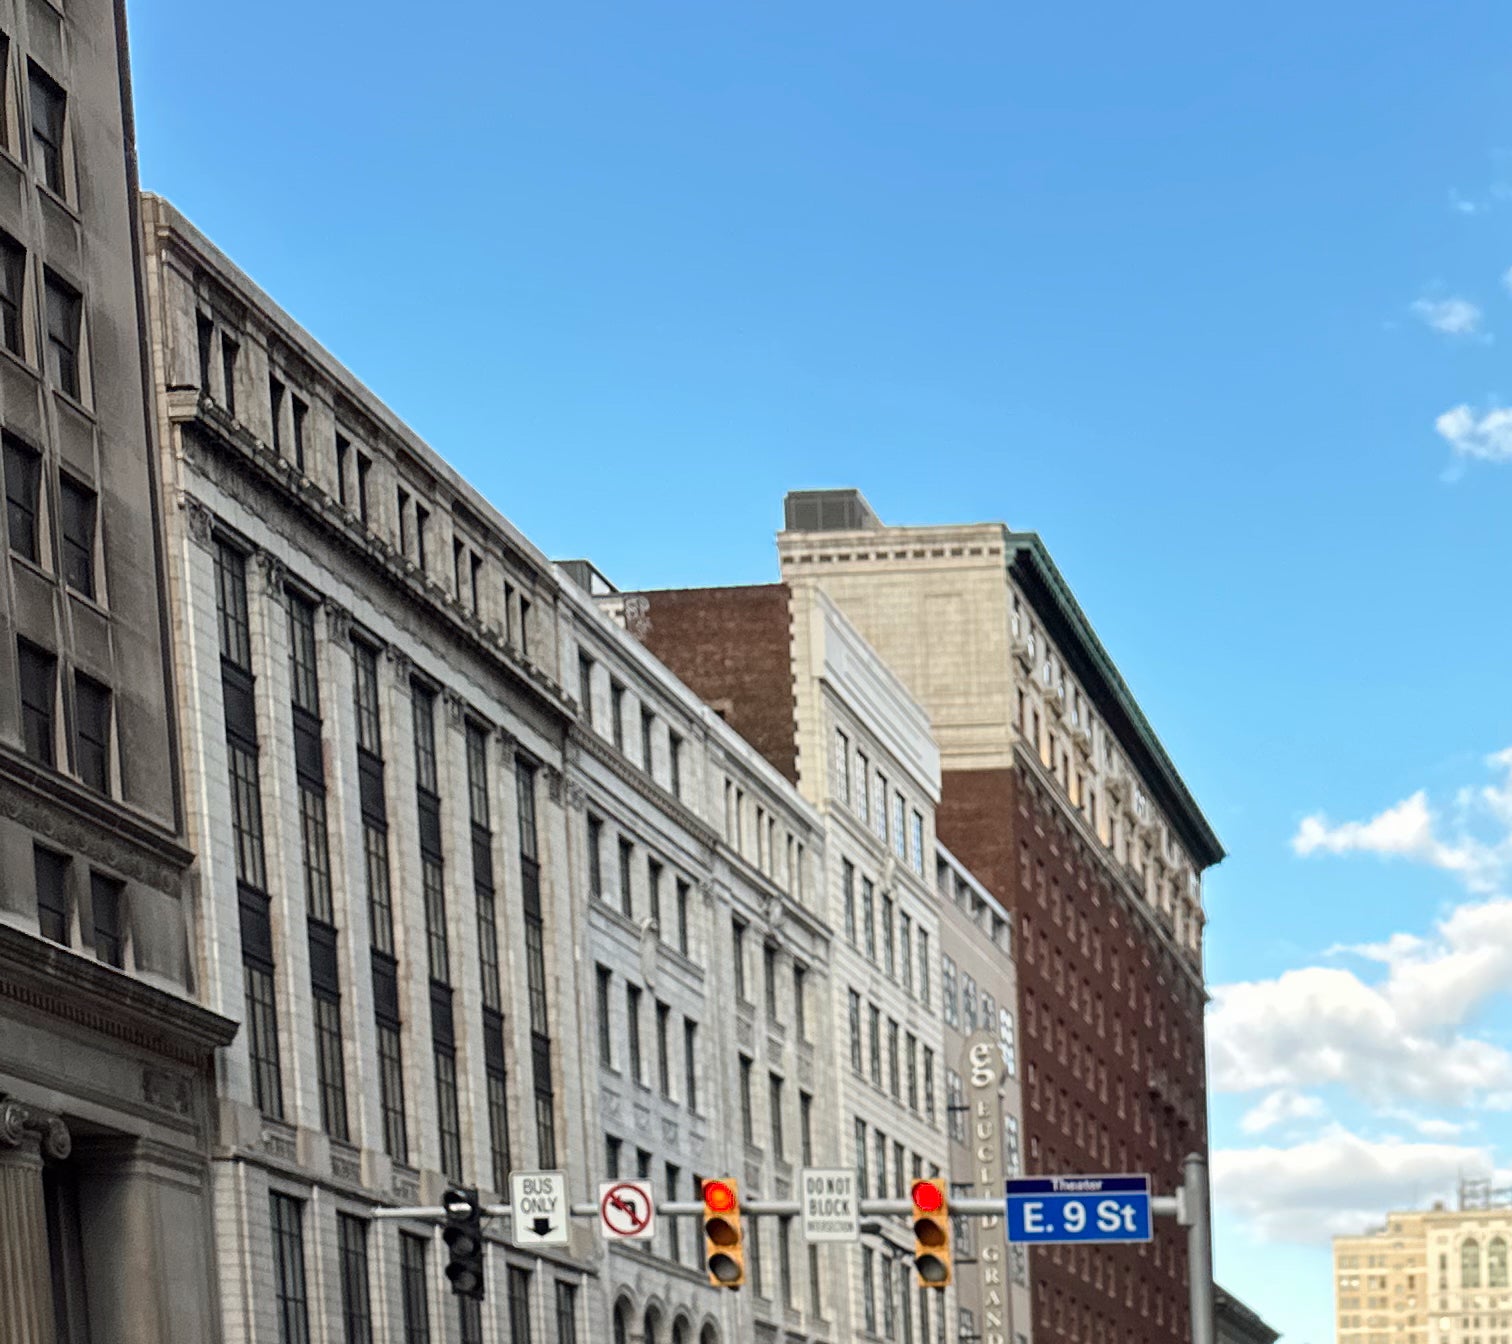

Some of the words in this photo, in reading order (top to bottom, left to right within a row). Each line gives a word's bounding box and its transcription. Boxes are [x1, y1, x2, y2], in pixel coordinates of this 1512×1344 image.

[523, 1178, 553, 1195] BUS
[807, 1177, 824, 1195] DO
[826, 1177, 851, 1195] NOT
[1051, 1179, 1103, 1192] Theater
[521, 1197, 558, 1214] ONLY
[809, 1199, 851, 1216] BLOCK
[1023, 1201, 1055, 1233] E.
[1063, 1200, 1087, 1233] 9
[1096, 1199, 1137, 1232] St
